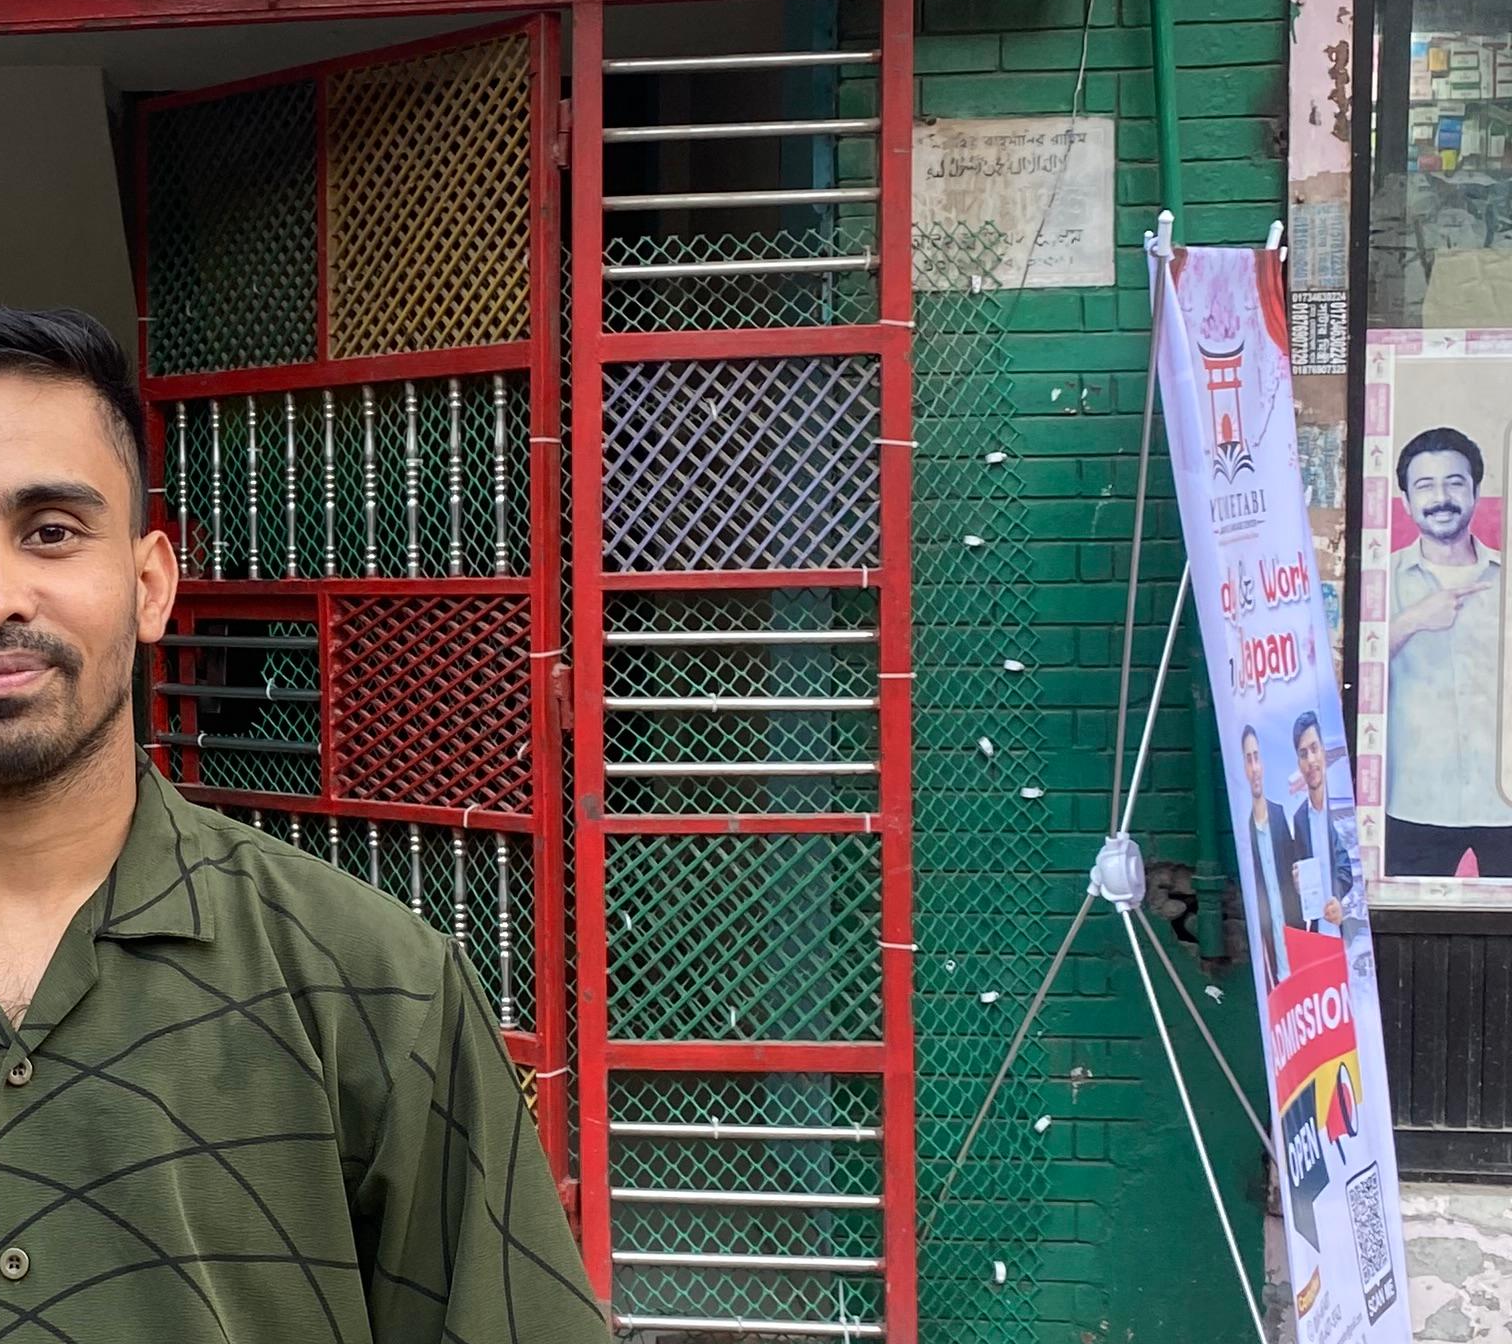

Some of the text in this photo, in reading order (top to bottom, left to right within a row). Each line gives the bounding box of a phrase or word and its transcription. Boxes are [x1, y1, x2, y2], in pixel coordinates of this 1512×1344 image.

[1259, 551, 1311, 603] Work
[1238, 626, 1297, 694] Japan
[1271, 982, 1354, 1076] ADMISSION
[1288, 1117, 1320, 1188] OPEN
[1368, 1278, 1396, 1318] SCAN ME
